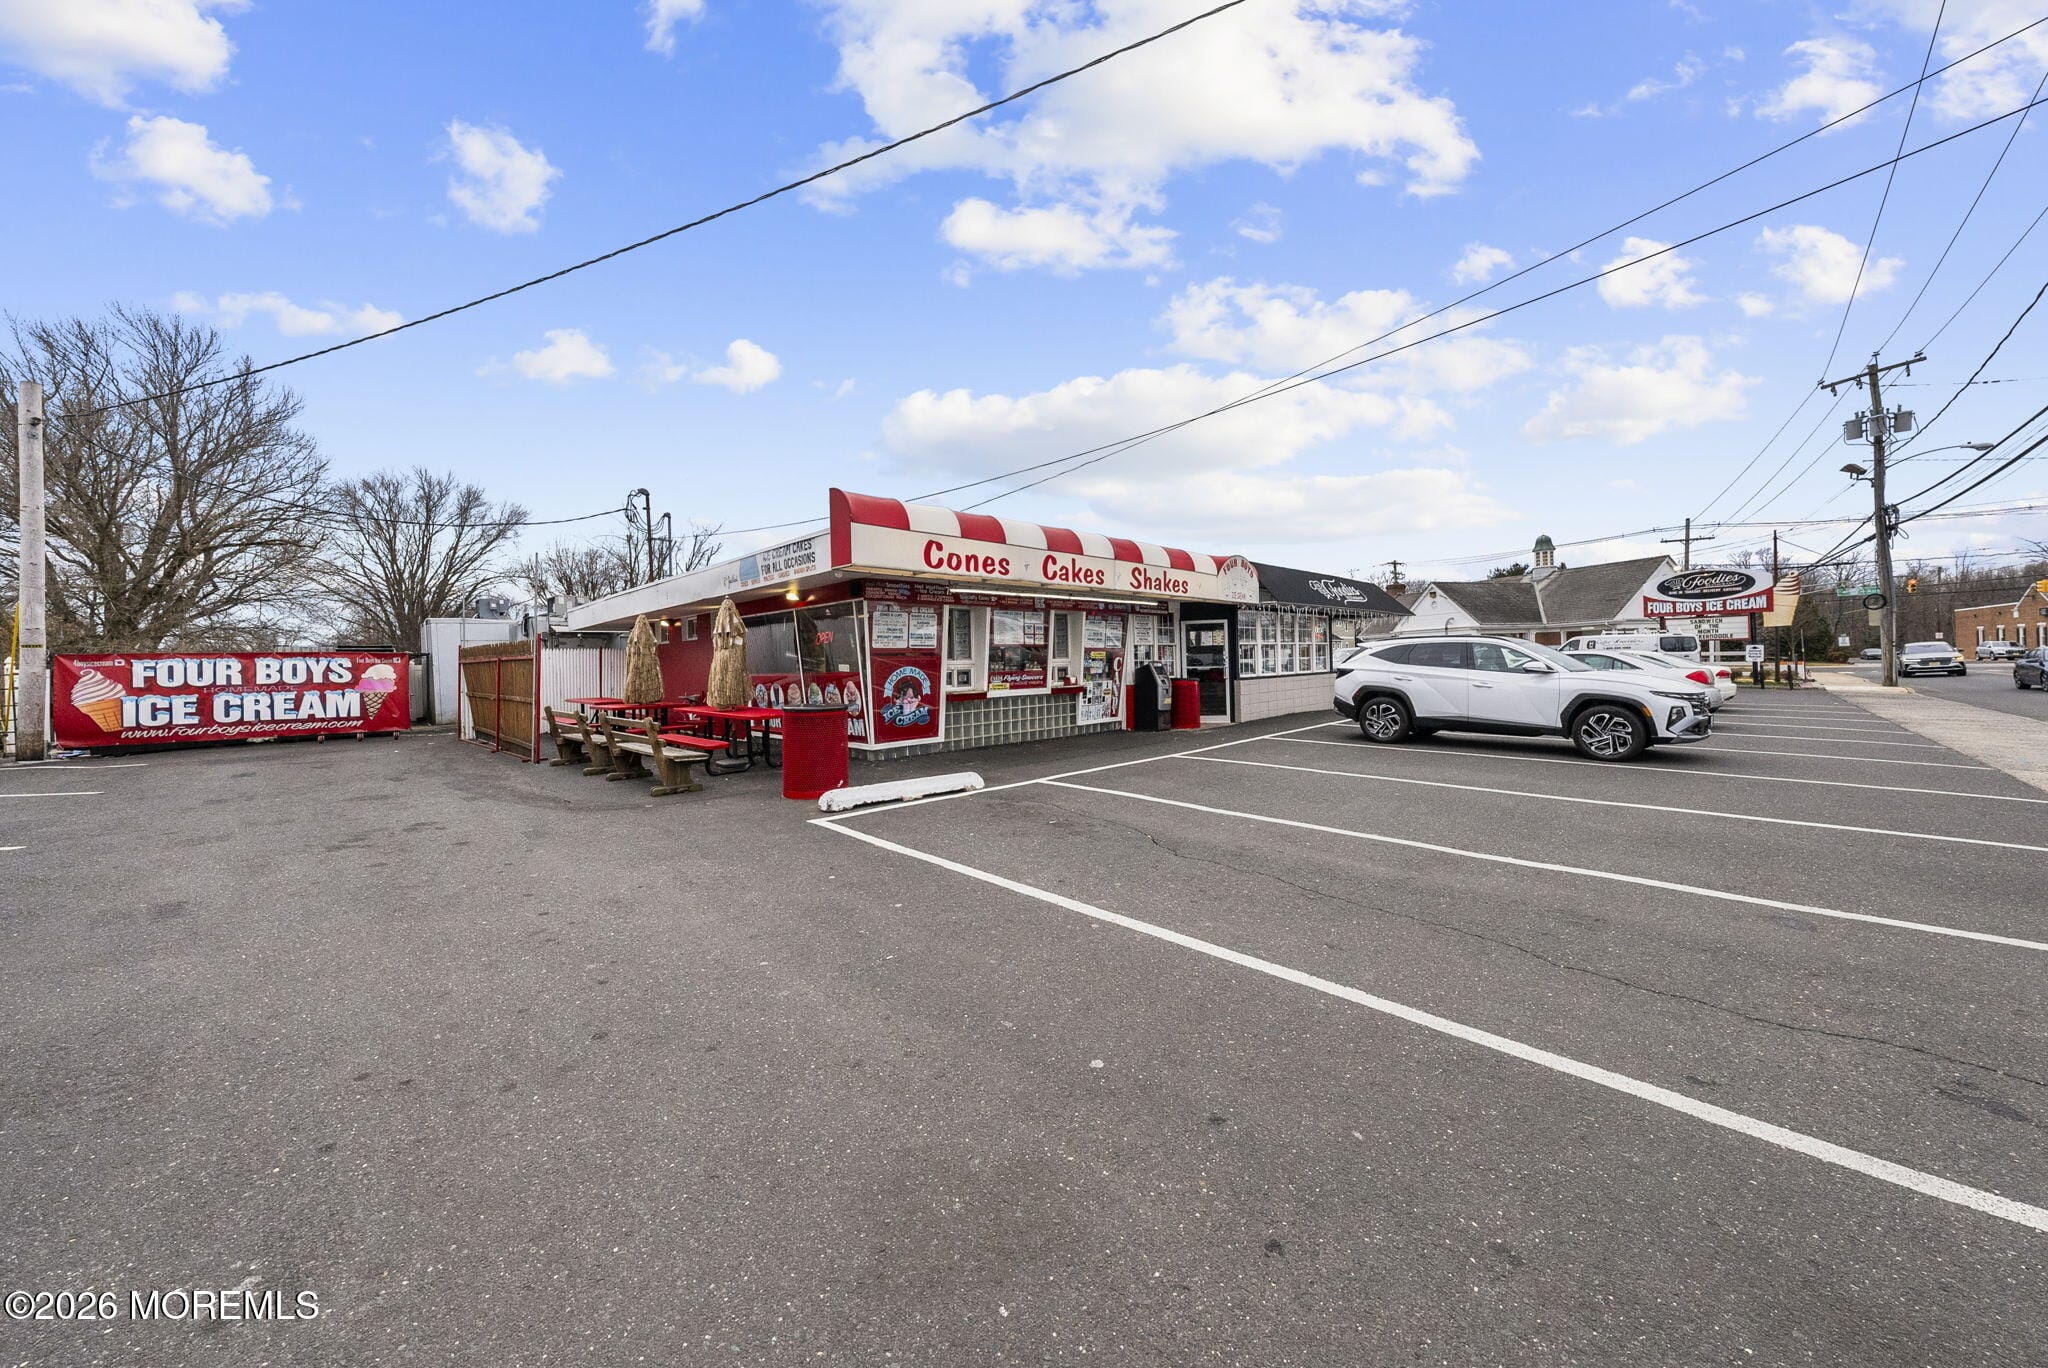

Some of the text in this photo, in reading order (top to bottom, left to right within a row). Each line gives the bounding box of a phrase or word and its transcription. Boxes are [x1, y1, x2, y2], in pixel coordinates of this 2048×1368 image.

[792, 539, 812, 554] CAKES
[761, 551, 816, 576] FOR ALL OCCASIONS
[923, 539, 1189, 594] Cones Cakes Shakes
[1222, 558, 1254, 579] FOUR BOYS
[1682, 571, 1746, 590] Foodies
[1647, 595, 1767, 614] FOUR BOYS ICE CREAM
[816, 631, 834, 645] OPEN
[131, 656, 353, 688] FOUR BOYS
[887, 667, 929, 690] HOME MADE
[203, 685, 299, 693] HOMEMADE
[120, 689, 362, 728] ICE CREAM
[883, 704, 929, 727] ICE CREAM
